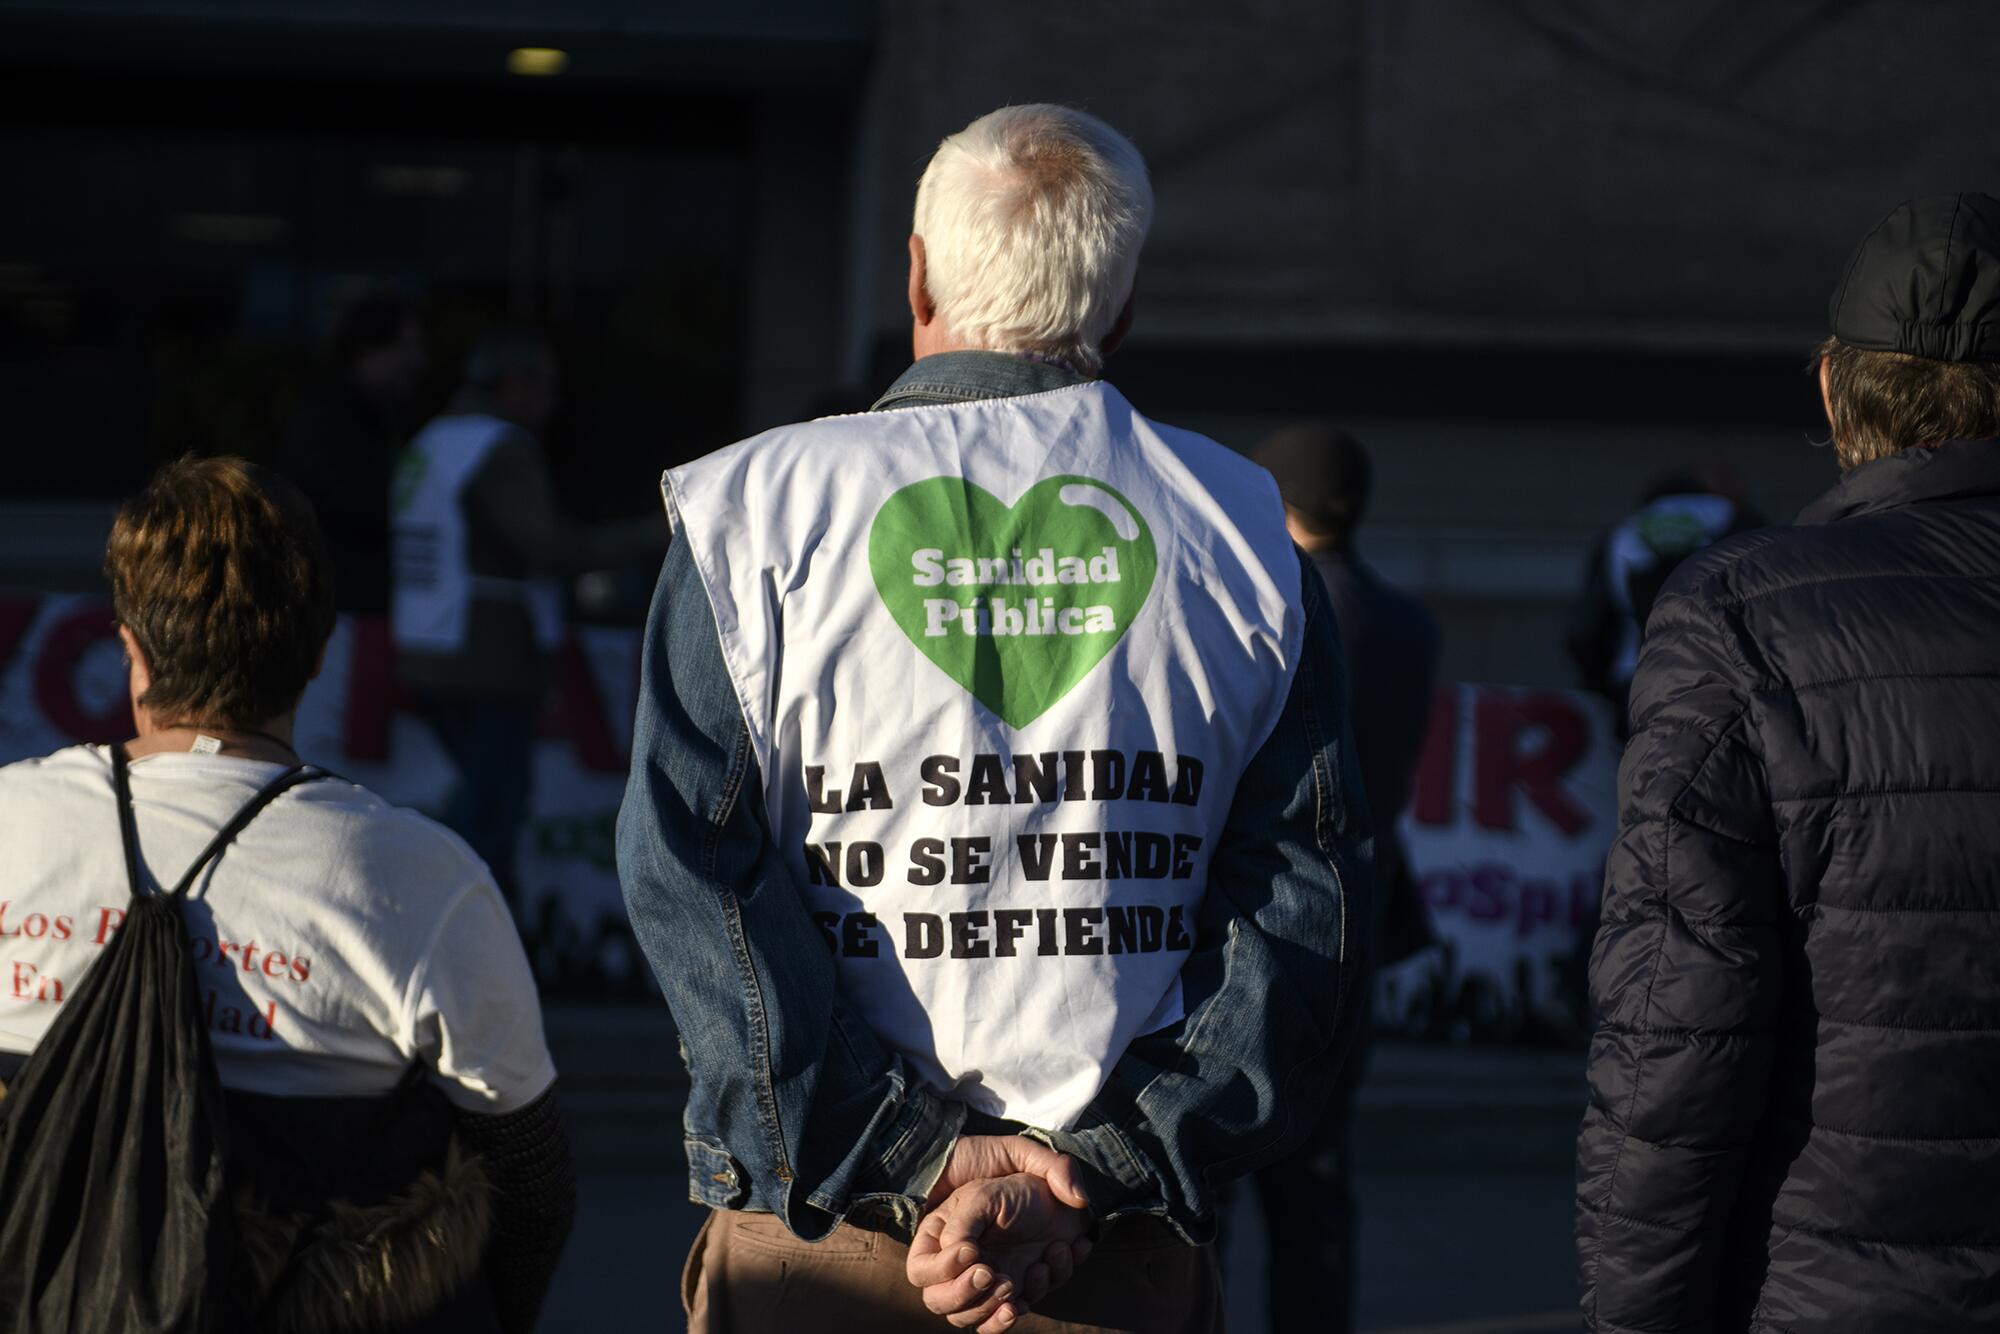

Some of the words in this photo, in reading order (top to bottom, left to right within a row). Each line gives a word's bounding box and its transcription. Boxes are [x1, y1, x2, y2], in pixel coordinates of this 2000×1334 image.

[911, 546, 1121, 587] Sanidad
[923, 597, 1116, 637] Pública
[805, 761, 894, 814] LA
[920, 749, 1204, 807] SANIDAD
[805, 841, 885, 888] NO
[907, 836, 991, 887] SE
[1017, 831, 1203, 882] VENDE
[0, 900, 73, 940] Los
[92, 906, 311, 982] Rortes
[903, 904, 1191, 959] DEFIENDE
[11, 960, 63, 1003] En
